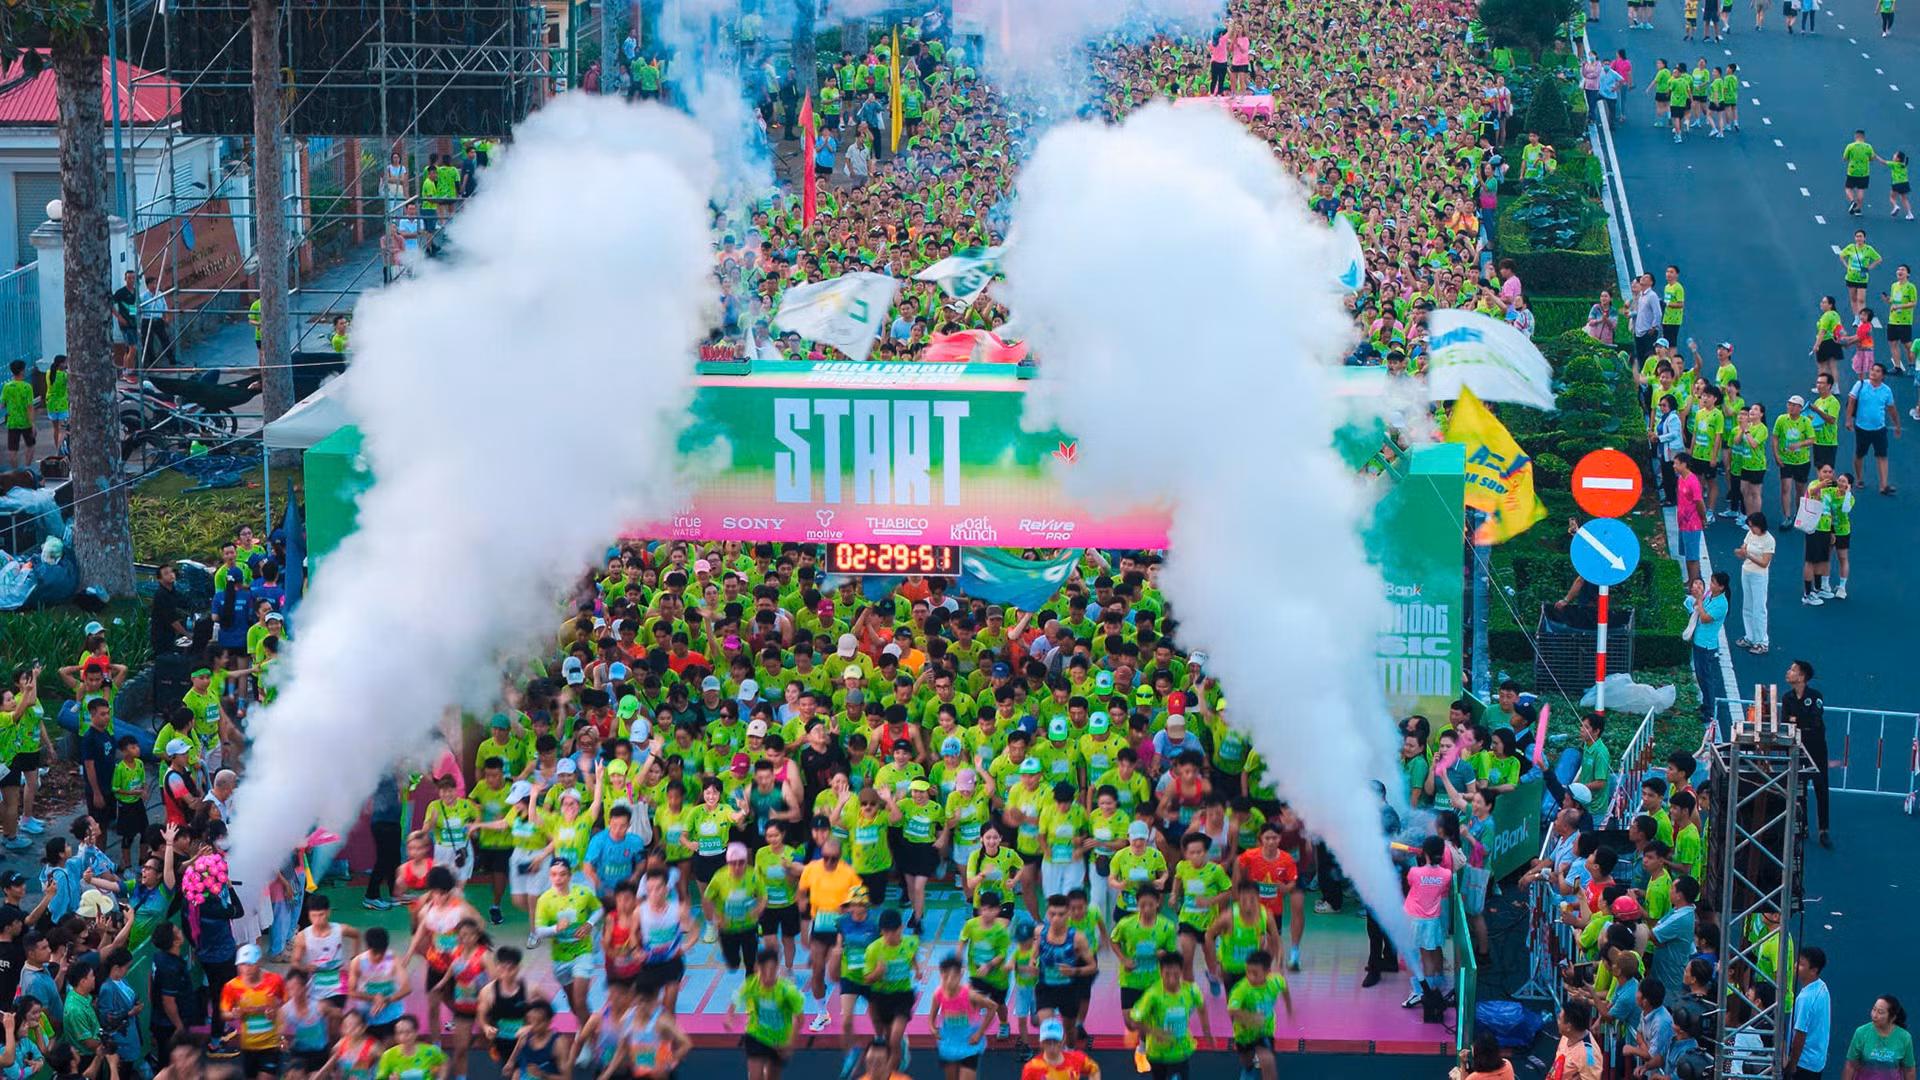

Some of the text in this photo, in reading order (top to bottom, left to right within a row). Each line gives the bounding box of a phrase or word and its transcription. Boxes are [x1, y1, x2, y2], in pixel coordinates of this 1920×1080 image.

[774, 398, 970, 506] START
[674, 515, 702, 528] true
[722, 517, 785, 530] SONY
[865, 517, 929, 529] THABICO
[964, 516, 990, 530] oat
[672, 529, 701, 537] WATER
[806, 529, 843, 538] motive
[950, 524, 997, 541] krunch
[1045, 532, 1071, 541] PRO
[836, 543, 951, 571] 02:29:51
[1488, 816, 1529, 861] PBank
